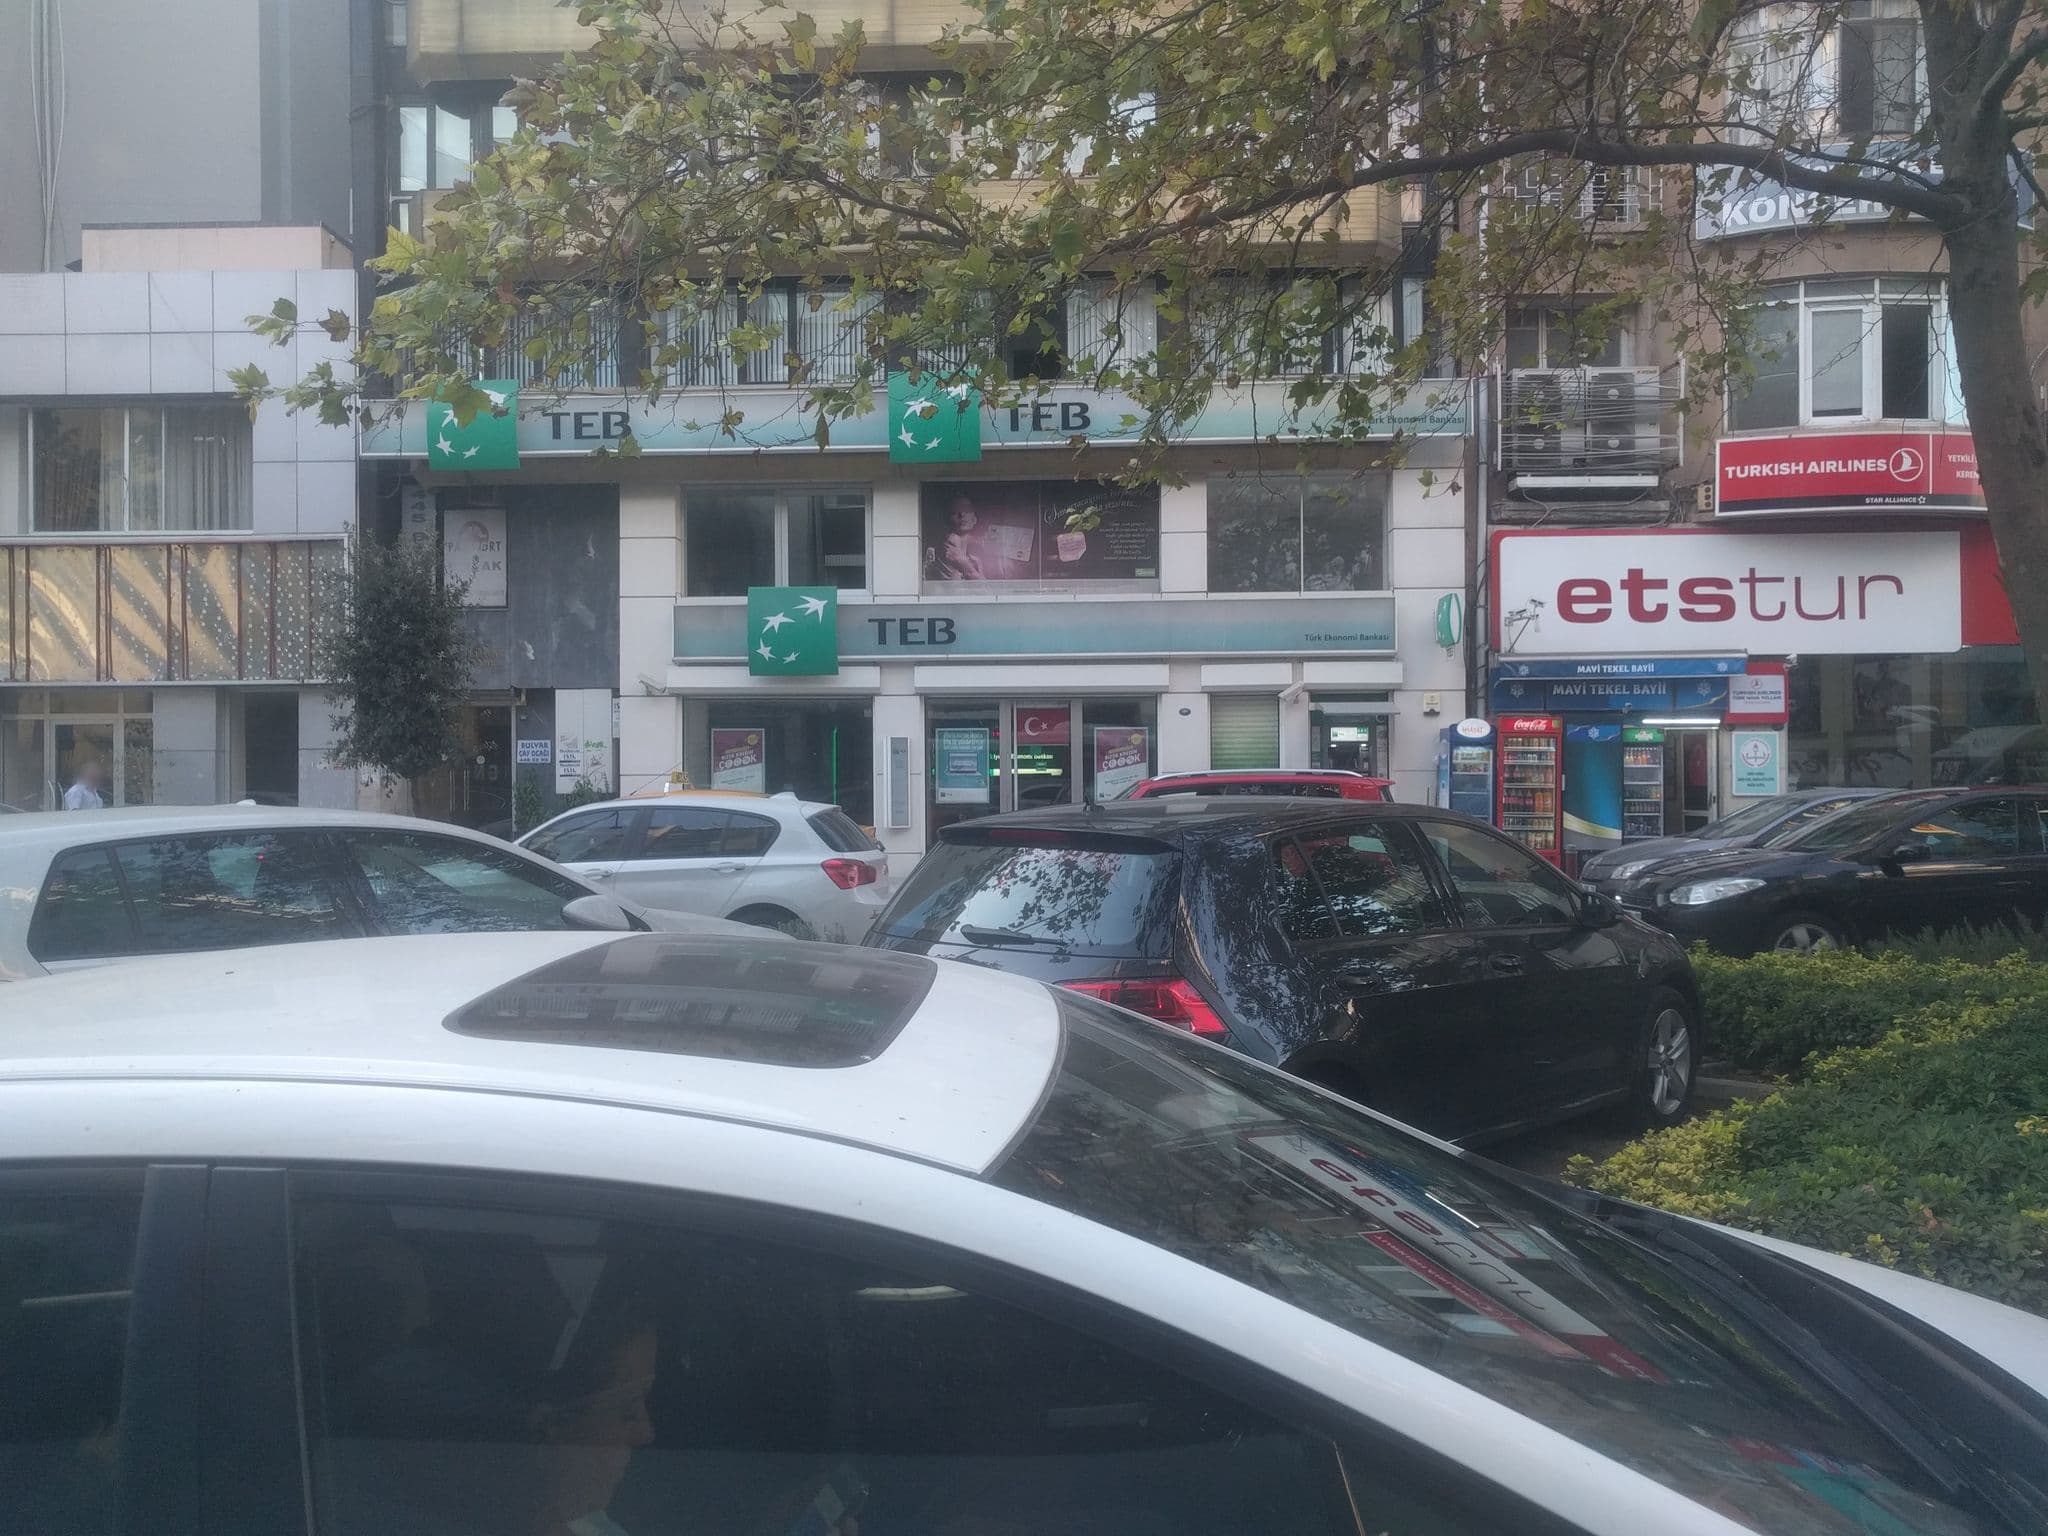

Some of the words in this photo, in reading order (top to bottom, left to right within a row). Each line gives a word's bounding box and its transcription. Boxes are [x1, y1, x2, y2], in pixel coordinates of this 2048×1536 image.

[1001, 402, 1091, 432] TEB
[1430, 414, 1465, 424] Bankası
[542, 411, 632, 440] TEB
[1725, 461, 1804, 479] TURKISH
[1807, 459, 1888, 474] AIRLINES
[1865, 496, 1884, 504] STAR
[1885, 496, 1917, 504] ALLIANCE
[1556, 567, 1904, 624] etstur
[868, 617, 957, 646] TEB
[1304, 632, 1322, 642] Türk
[1324, 632, 1358, 641] Ekonomi
[1360, 632, 1390, 641] Bankası
[1577, 663, 1600, 674] MAVİ
[1602, 664, 1629, 673] TEKEL
[1631, 663, 1655, 673] BAYİİ
[1552, 682, 1587, 696] MAVİ
[1590, 682, 1629, 695] TEKEL
[1632, 681, 1667, 695] BAYİİ
[521, 741, 549, 749] BULVAR
